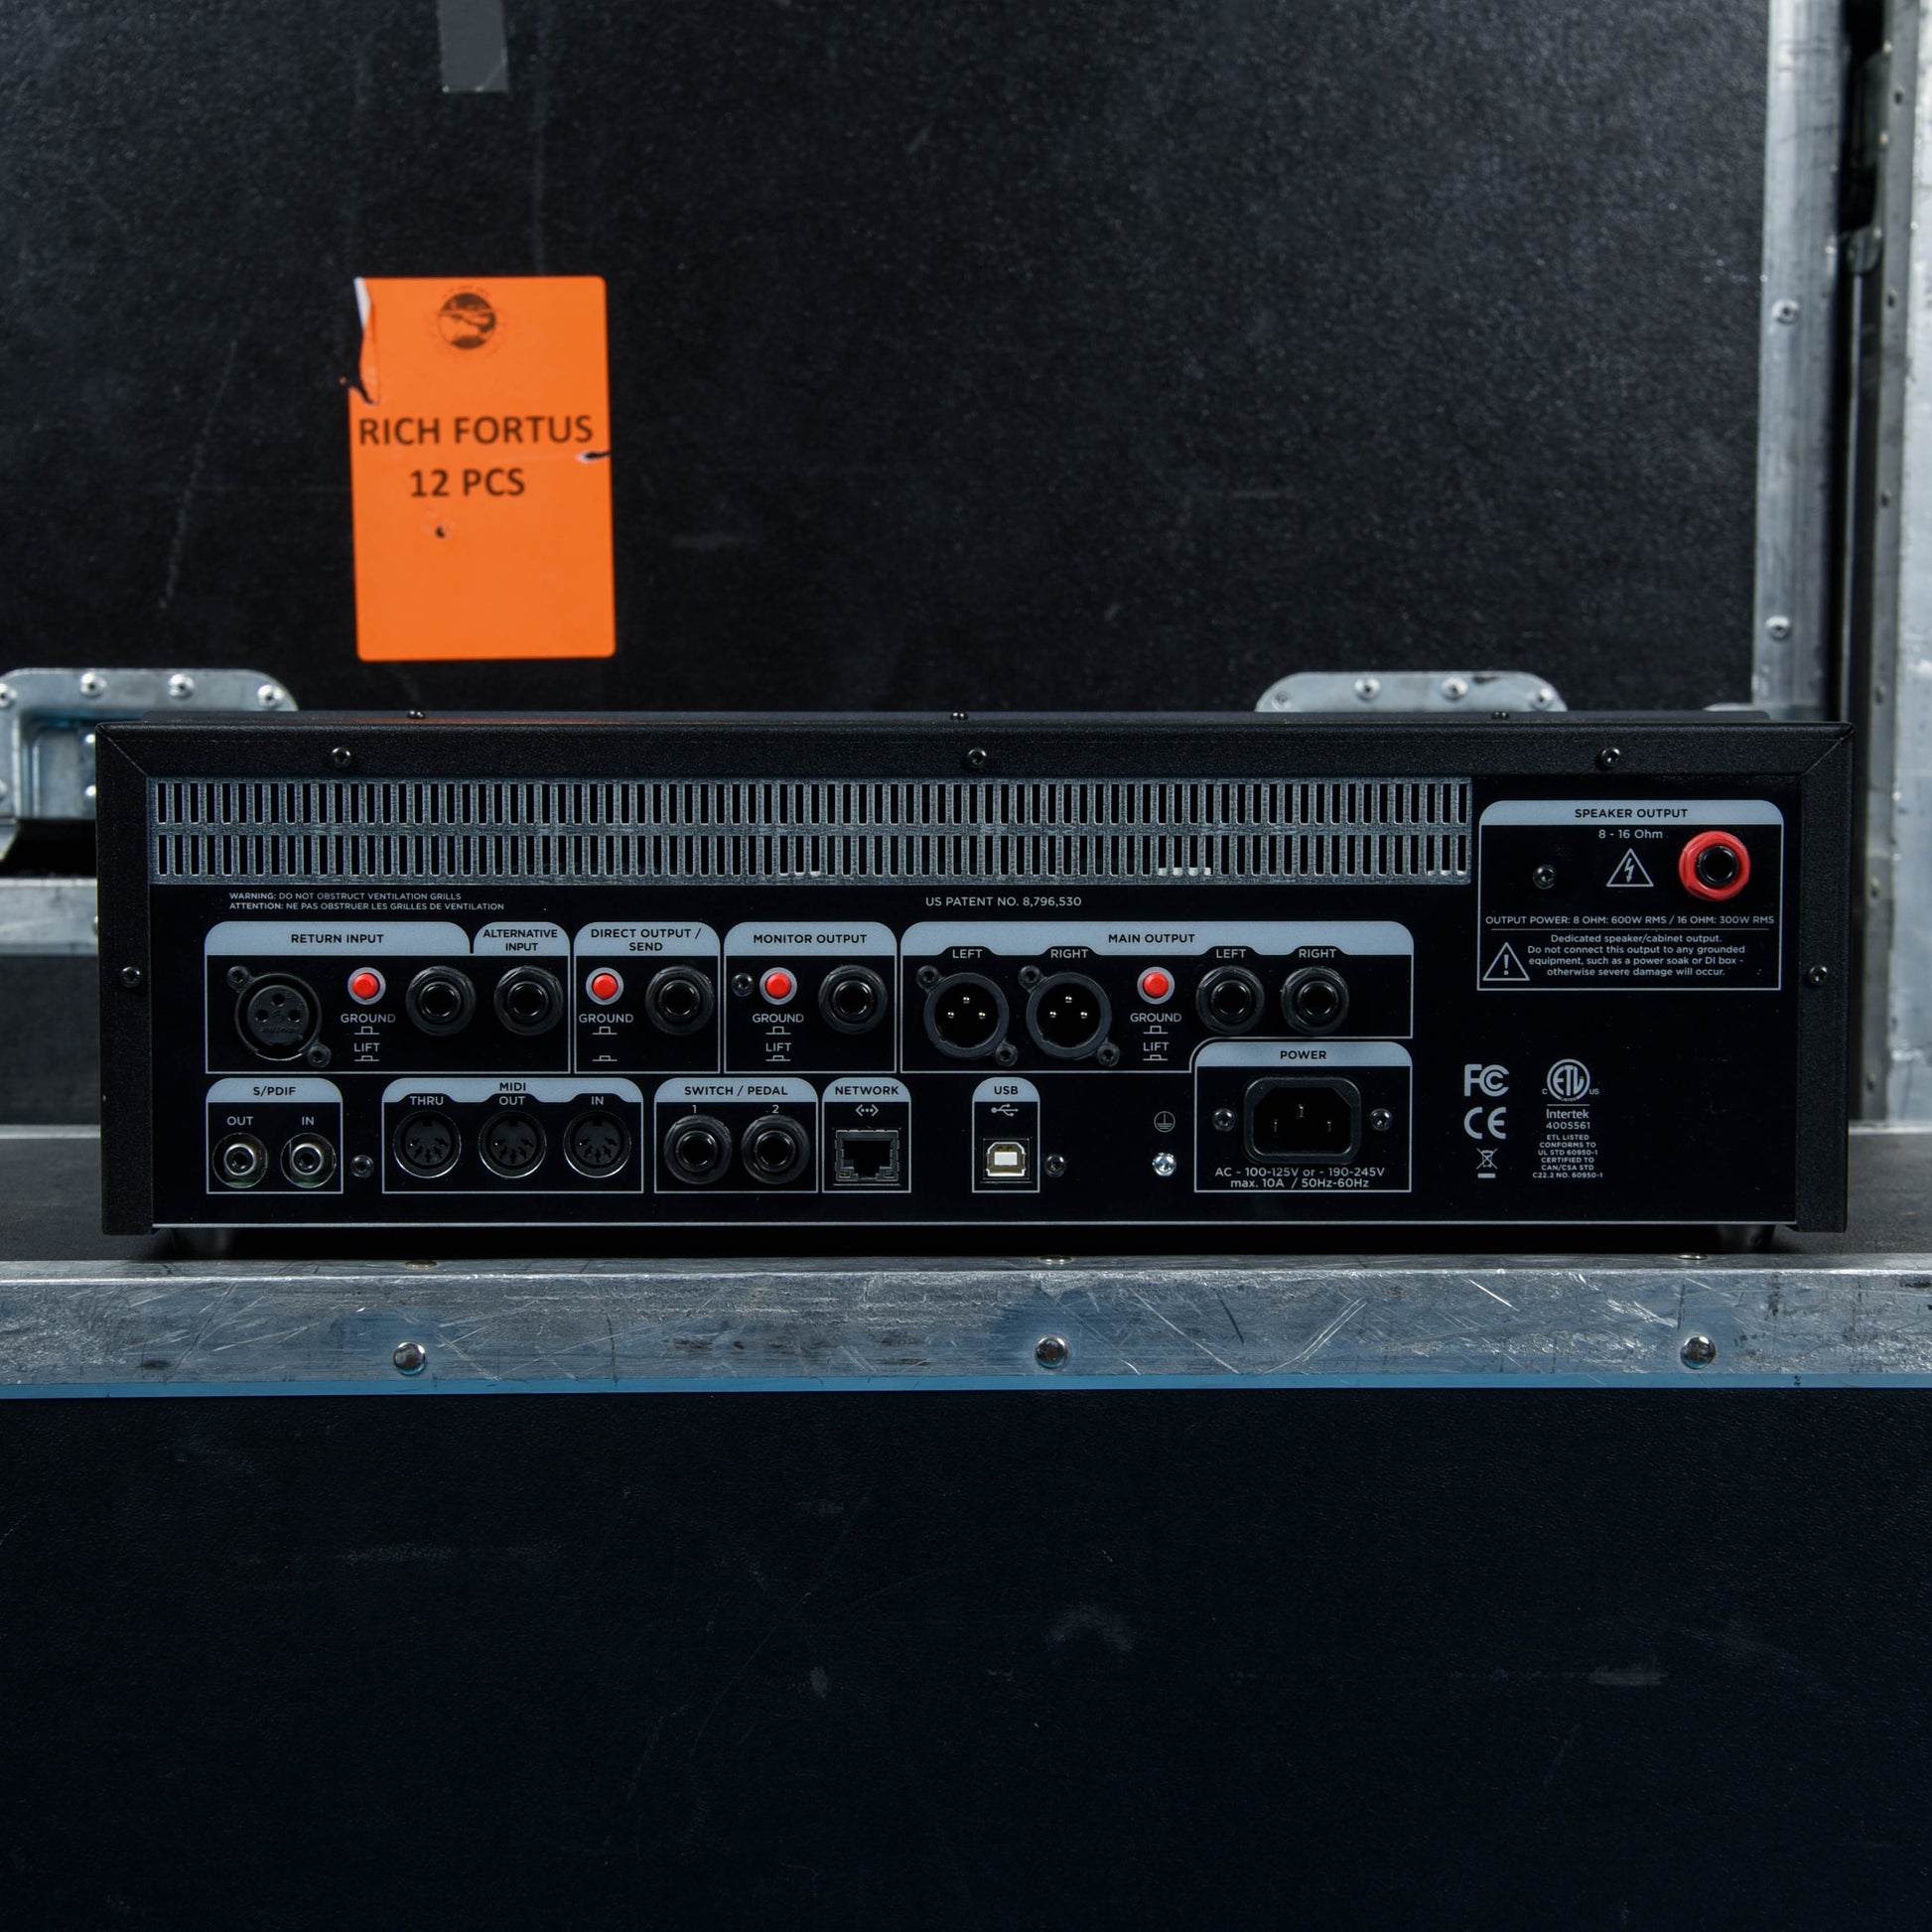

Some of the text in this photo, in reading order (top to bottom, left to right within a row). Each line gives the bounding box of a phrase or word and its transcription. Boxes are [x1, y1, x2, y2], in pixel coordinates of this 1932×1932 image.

[359, 415, 593, 446] RICH FORTUS
[411, 468, 525, 497] 12 PCS
[1575, 808, 1688, 818] SPEAKER OUTPUT
[1598, 829, 1606, 839] 8
[1618, 829, 1630, 839] 16
[1634, 829, 1663, 839] Ohm
[946, 897, 993, 906] PATENT
[997, 897, 1019, 906] NO.
[1023, 897, 1082, 907] 8,796,530
[1530, 915, 1571, 924] POWER:
[1573, 915, 1580, 924] 8
[1582, 915, 1608, 924] OHM:
[1611, 915, 1642, 924] 600W
[1645, 915, 1667, 924] RMS
[1677, 915, 1688, 924] 16
[1690, 915, 1717, 924] OHM:
[1720, 915, 1750, 924] 300W
[1752, 915, 1774, 924] RMS
[483, 929, 559, 938] ALTERNATIVE
[591, 928, 636, 938] DIRECT
[640, 928, 691, 938] OUTPUT
[1108, 933, 1195, 943] MAIN OUTPUT
[291, 934, 384, 943] RETURN INPUT
[754, 934, 867, 943] MONITOR OUTPUT
[1604, 933, 1683, 944] speaker/cabinet
[1686, 934, 1722, 943] output.
[505, 942, 538, 951] INPUT
[629, 942, 663, 951] SEND
[1528, 945, 1542, 954] Do
[1626, 946, 1660, 955] output
[1676, 946, 1694, 955] any
[1697, 945, 1745, 955] grounded
[952, 949, 983, 958] LEFT
[1050, 949, 1089, 959] RIGHT
[1216, 949, 1247, 958] LEFT
[1299, 949, 1336, 959] RIGHT
[1529, 956, 1584, 966] equipment,
[1587, 956, 1608, 965] such
[1666, 956, 1689, 965] soak
[1705, 956, 1716, 965] DI
[1547, 967, 1595, 976] otherwise
[1632, 967, 1673, 977] damage
[341, 1014, 395, 1023] GROUND
[579, 1014, 633, 1024] GROUND
[753, 1013, 804, 1023] GROUND
[1130, 1013, 1181, 1023] GROUND
[354, 1042, 380, 1052] LIFT
[765, 1042, 791, 1052] LIFT
[1143, 1041, 1170, 1051] LIFT
[1280, 1050, 1326, 1059] POWER
[253, 1085, 296, 1097] S/PDIF
[499, 1082, 526, 1091] MIDI
[684, 1086, 734, 1095] SWITCH
[748, 1086, 788, 1095] PEDAL
[835, 1086, 898, 1095] NETWORK
[994, 1085, 1019, 1095] USB
[409, 1096, 444, 1106] THRU
[498, 1096, 525, 1105] OUT
[592, 1096, 604, 1105] IN
[692, 1104, 697, 1114] 1
[772, 1104, 779, 1114] 2
[1546, 1109, 1589, 1119] Intertek
[226, 1116, 253, 1126] OUT
[302, 1116, 314, 1125] IN
[1463, 1107, 1506, 1140] CE
[1546, 1121, 1590, 1130] 4005561
[1215, 1168, 1232, 1176] AC
[1245, 1167, 1300, 1176] 100-125V
[1328, 1167, 1385, 1176] 190-245V
[1262, 1178, 1285, 1187] 10A
[1302, 1177, 1369, 1187] 50Hz-60Hz
